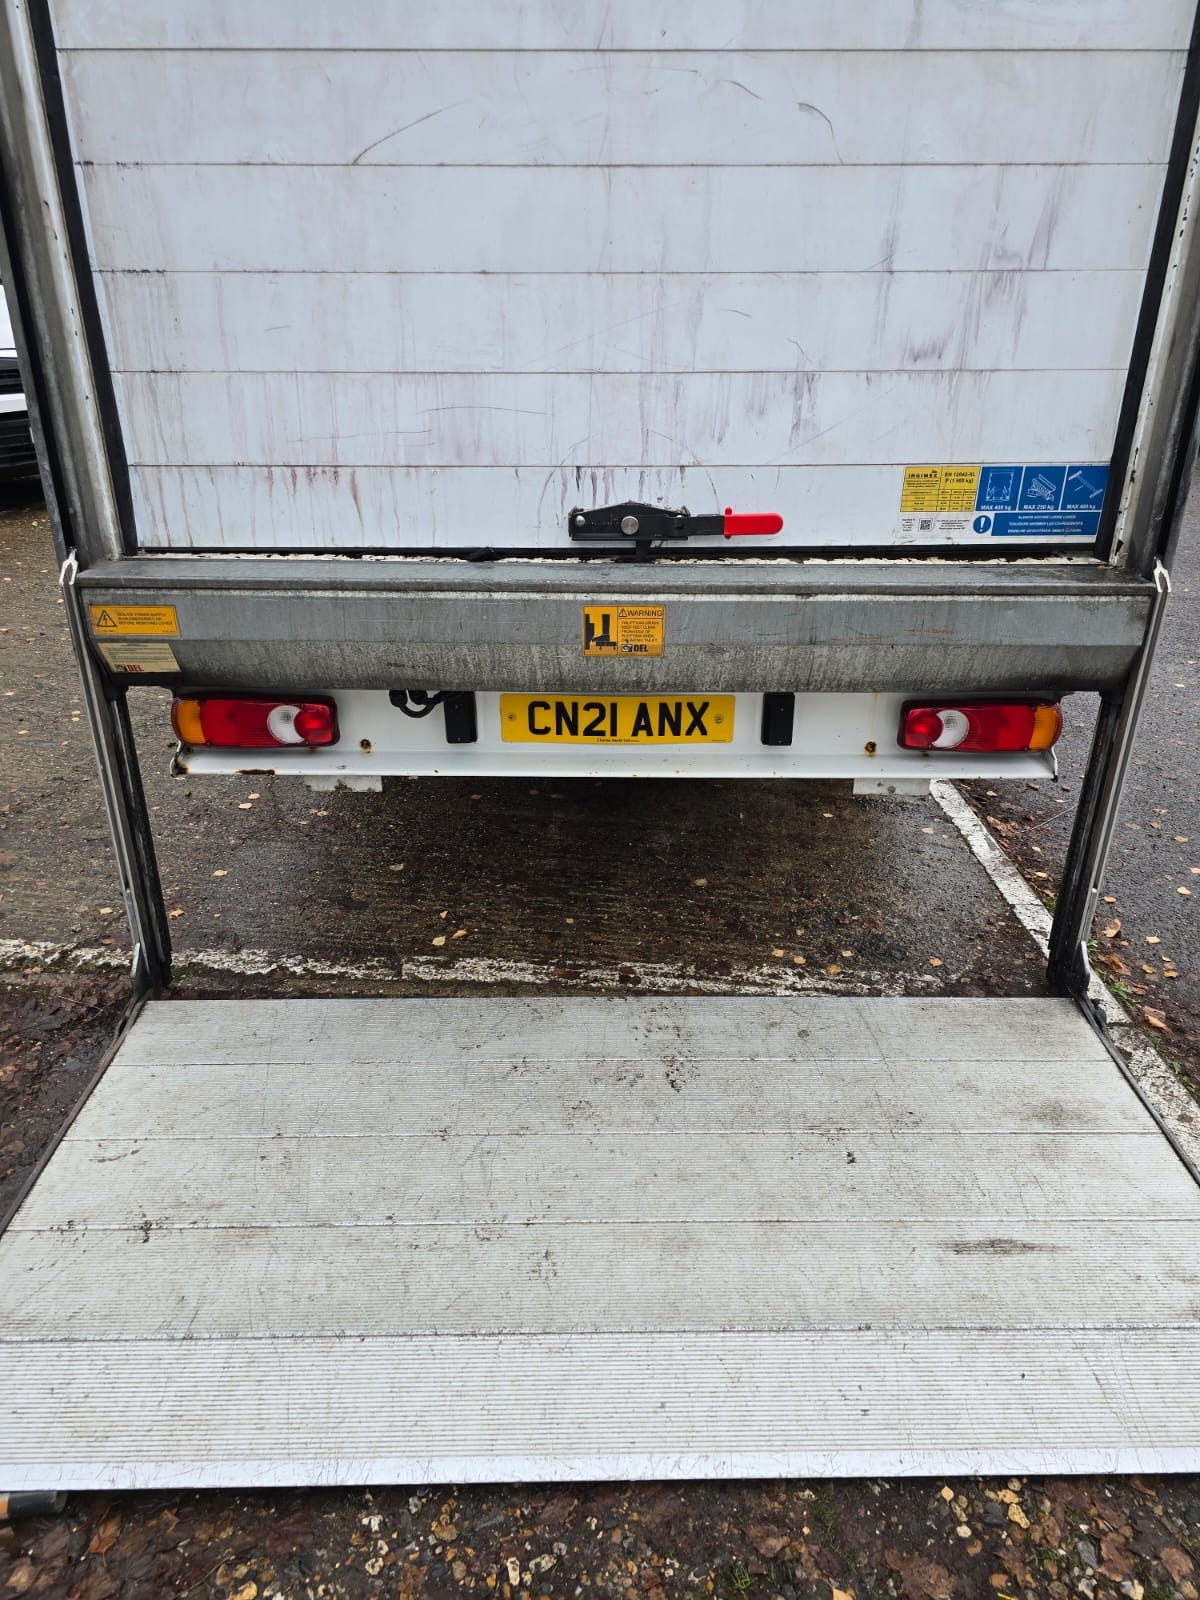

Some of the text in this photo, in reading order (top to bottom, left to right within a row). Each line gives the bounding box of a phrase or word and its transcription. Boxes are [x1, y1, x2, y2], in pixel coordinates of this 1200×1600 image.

[633, 644, 648, 652] DEL
[527, 701, 710, 737] CN21 ANX
